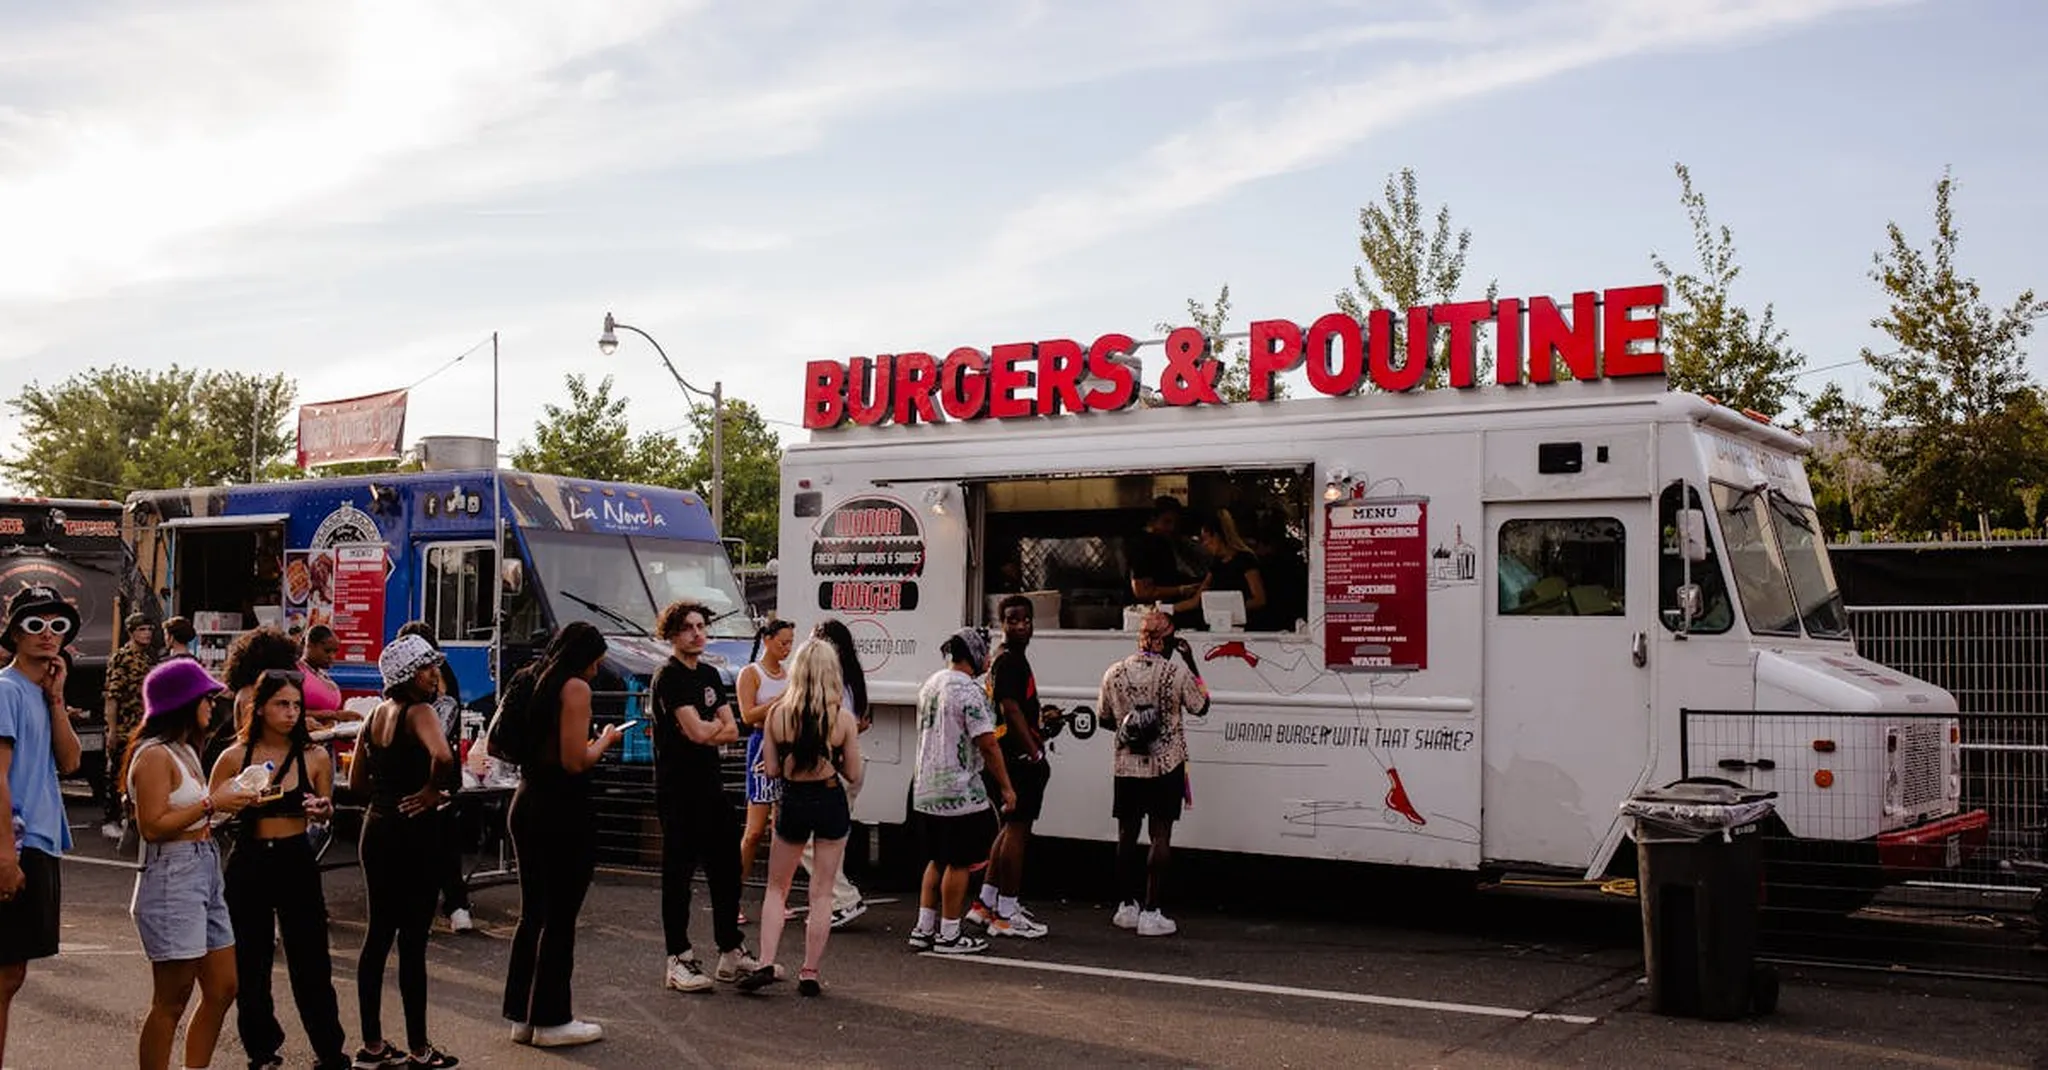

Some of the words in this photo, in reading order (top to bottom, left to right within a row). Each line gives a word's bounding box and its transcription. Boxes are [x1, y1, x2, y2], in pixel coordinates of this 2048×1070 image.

[804, 333, 1143, 430] BURGERS
[1161, 327, 1226, 406] &
[1249, 284, 1668, 402] POUTINE
[569, 496, 598, 520] La
[603, 497, 667, 528] Novela
[834, 508, 902, 536] WANNA
[1352, 507, 1398, 520] MENU
[831, 582, 902, 610] BURGER
[1224, 721, 1272, 743] WANNA
[1275, 724, 1328, 746] BURGER
[1331, 727, 1369, 747] WITH
[1373, 728, 1410, 749] THAT
